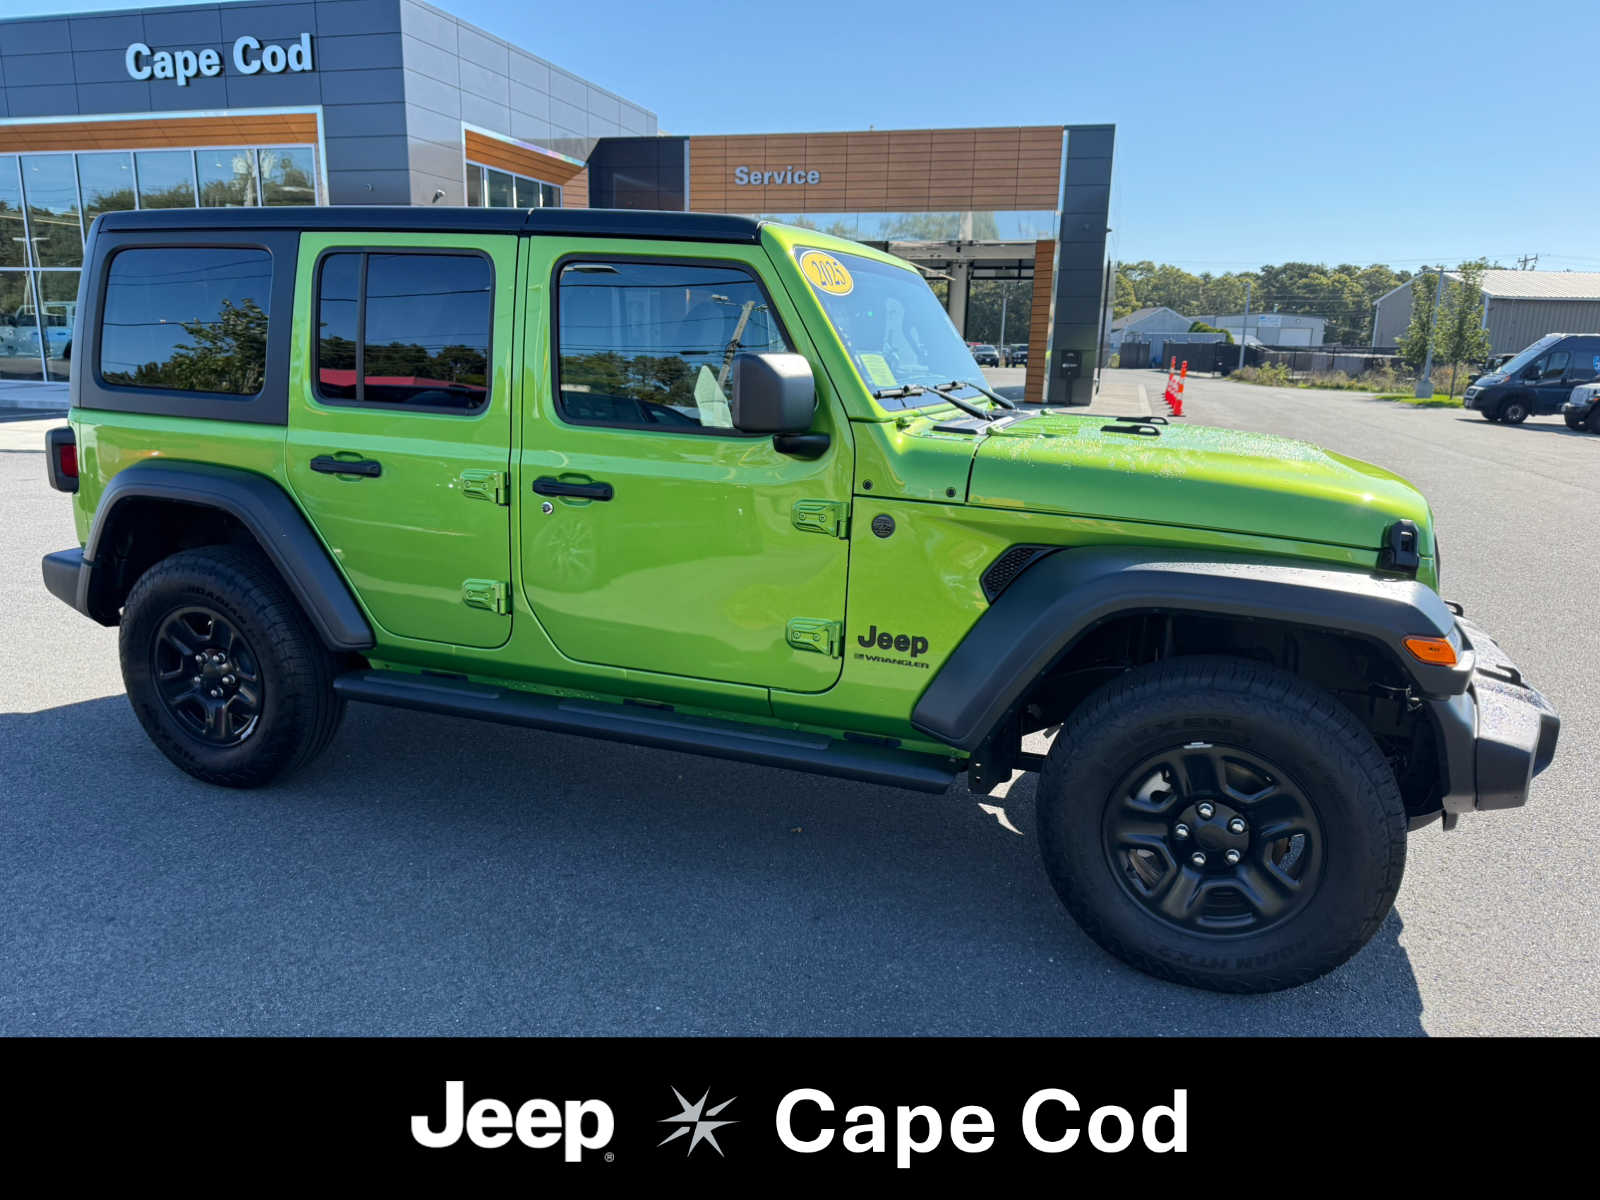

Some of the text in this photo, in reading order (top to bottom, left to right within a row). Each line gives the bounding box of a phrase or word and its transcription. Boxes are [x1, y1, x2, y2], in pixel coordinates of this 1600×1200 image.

[125, 32, 313, 86] Cape Cod
[735, 165, 820, 185] Service
[810, 259, 847, 286] 2025
[857, 625, 930, 658] Jeep
[864, 653, 930, 669] WRANGLER
